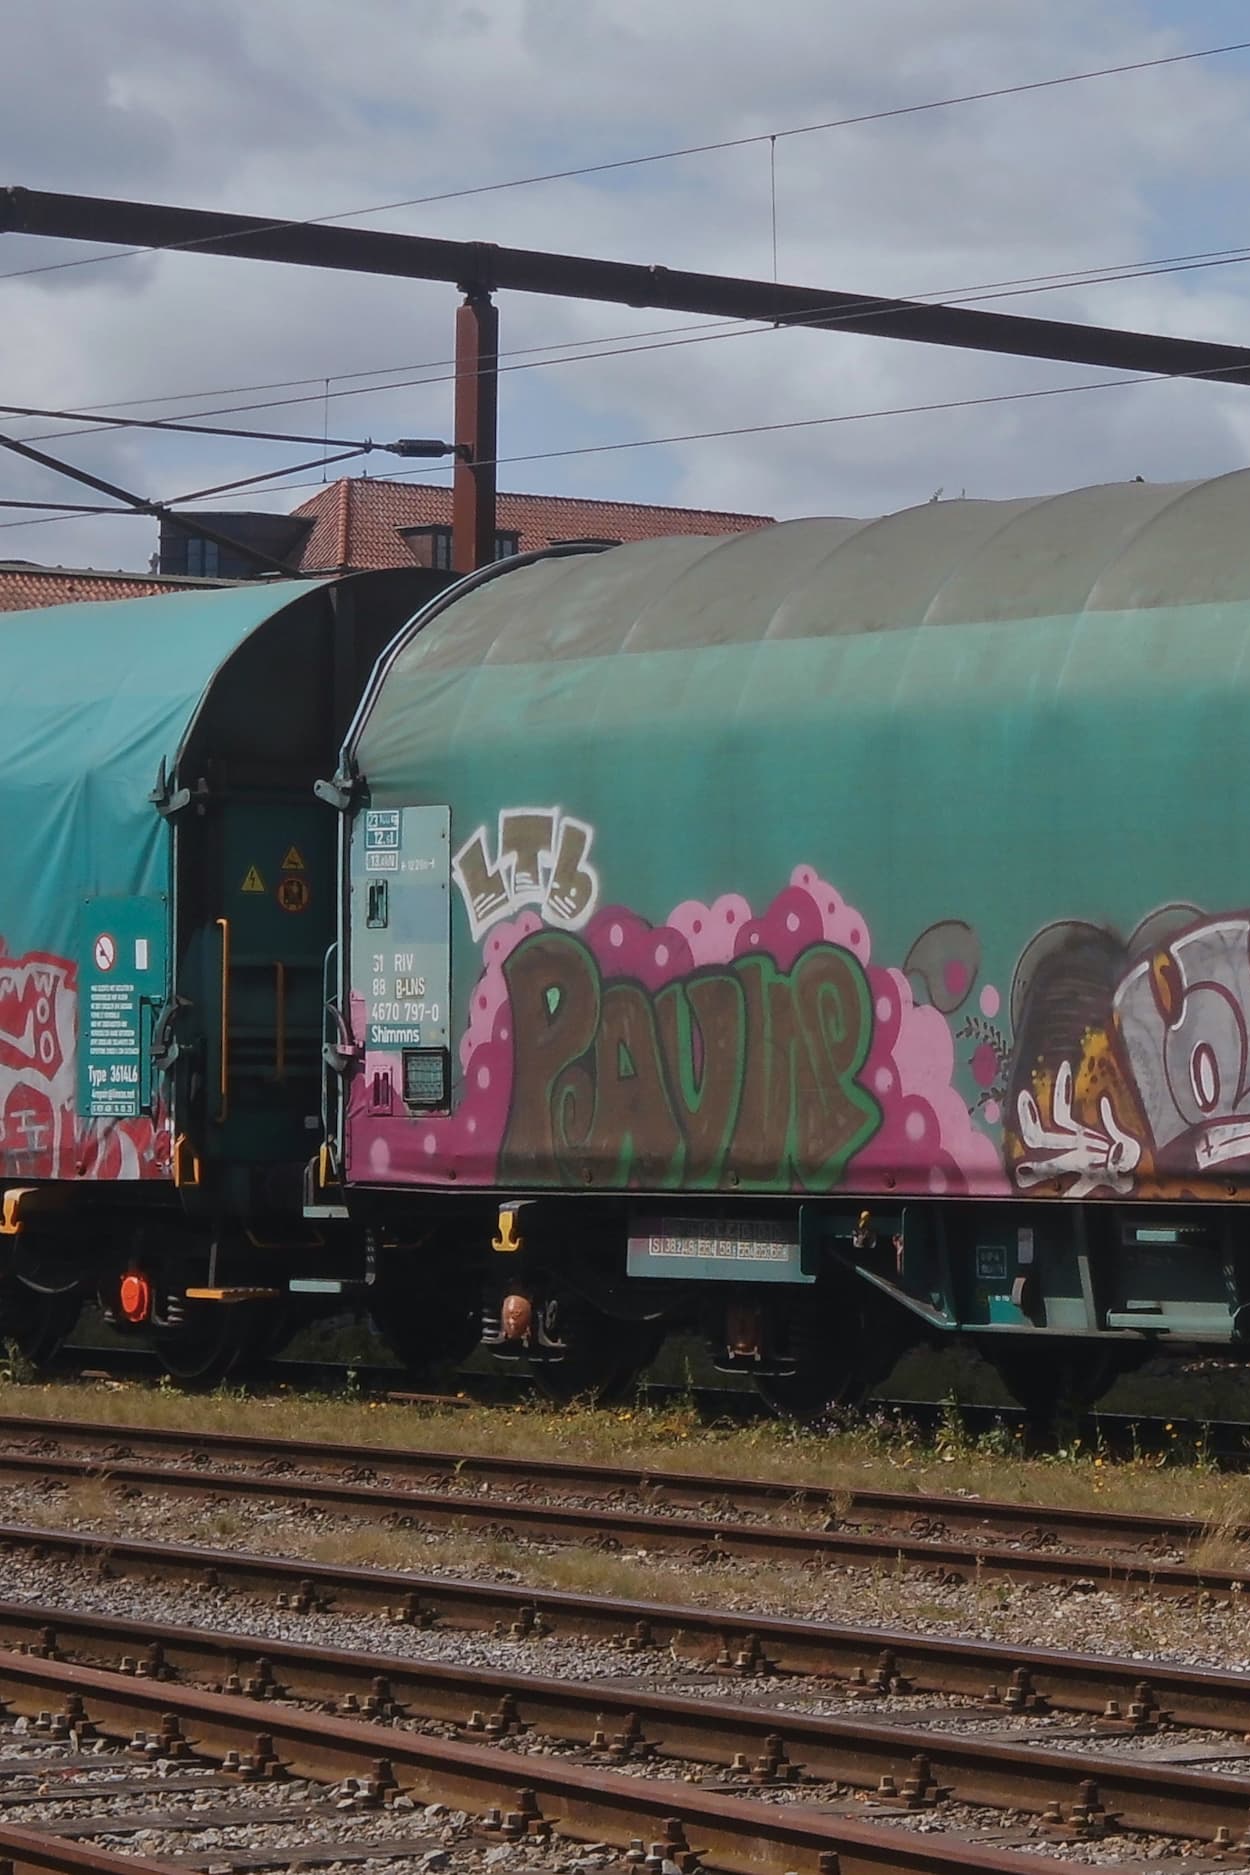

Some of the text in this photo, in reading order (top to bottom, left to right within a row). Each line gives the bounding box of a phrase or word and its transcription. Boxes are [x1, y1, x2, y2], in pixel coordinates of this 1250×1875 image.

[394, 953, 414, 972] RIV
[372, 977, 425, 998] 88 B-LNS
[371, 1003, 439, 1022] 4670 797-0
[371, 1025, 420, 1043] Shimmns
[88, 1064, 107, 1087] Type
